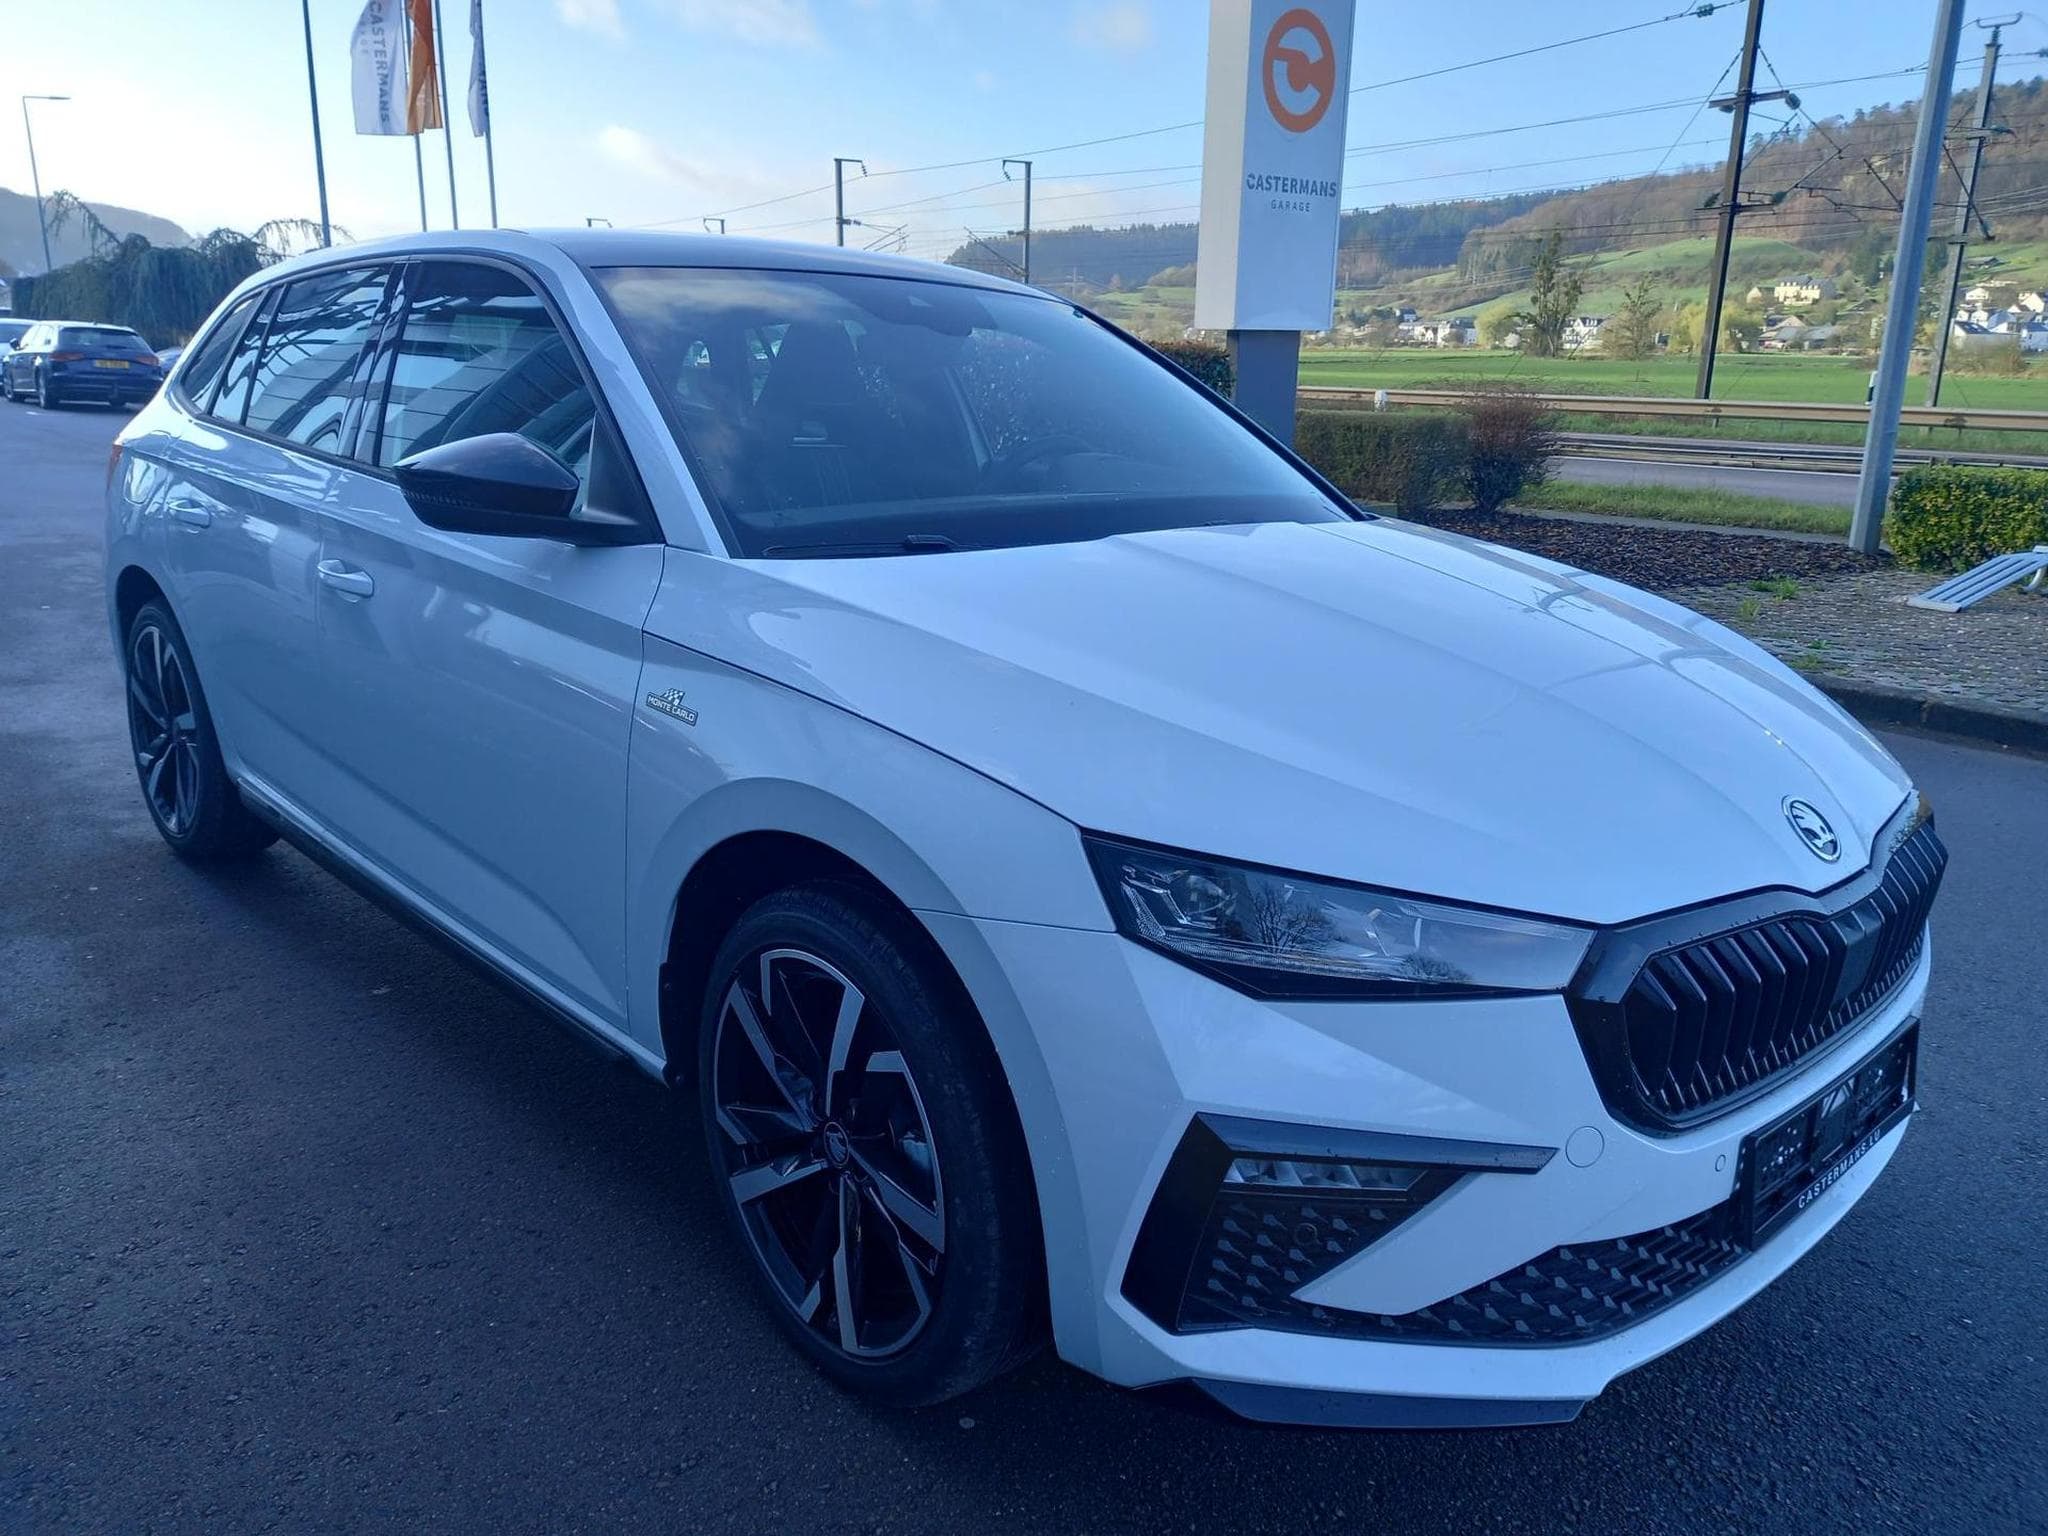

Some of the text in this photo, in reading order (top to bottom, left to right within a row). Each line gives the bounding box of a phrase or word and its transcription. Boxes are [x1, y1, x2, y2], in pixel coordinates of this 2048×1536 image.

[369, 0, 391, 123] CASTERMANS
[1246, 173, 1337, 198] CASTERMANS
[1271, 199, 1311, 212] GARAGE
[647, 696, 695, 722] MONTE CARLO
